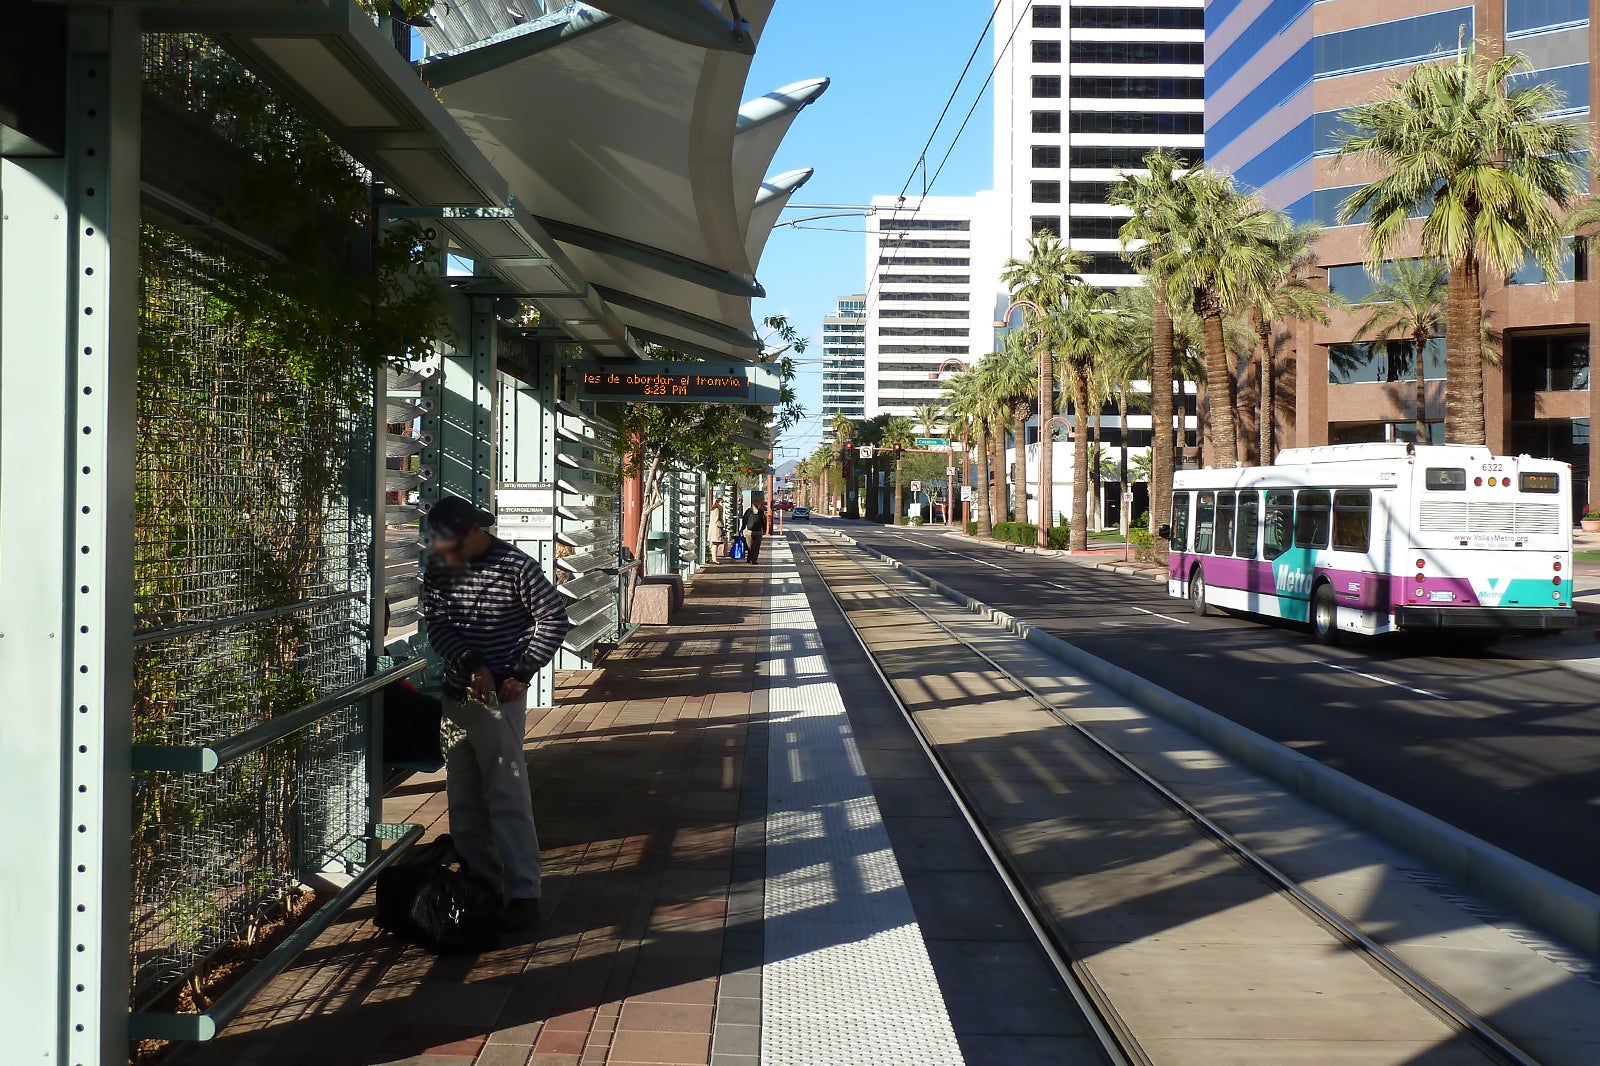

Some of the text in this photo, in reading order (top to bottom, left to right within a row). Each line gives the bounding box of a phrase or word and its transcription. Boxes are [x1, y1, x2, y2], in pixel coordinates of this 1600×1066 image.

[607, 373, 620, 384] de
[626, 374, 674, 385] abordar
[680, 375, 690, 386] el
[644, 385, 687, 397] 3:23 PM
[1482, 463, 1504, 472] 6322
[1453, 534, 1529, 543] www.ValleyMetro.org
[1276, 563, 1313, 594] Metro
[1477, 590, 1504, 599] Metro
